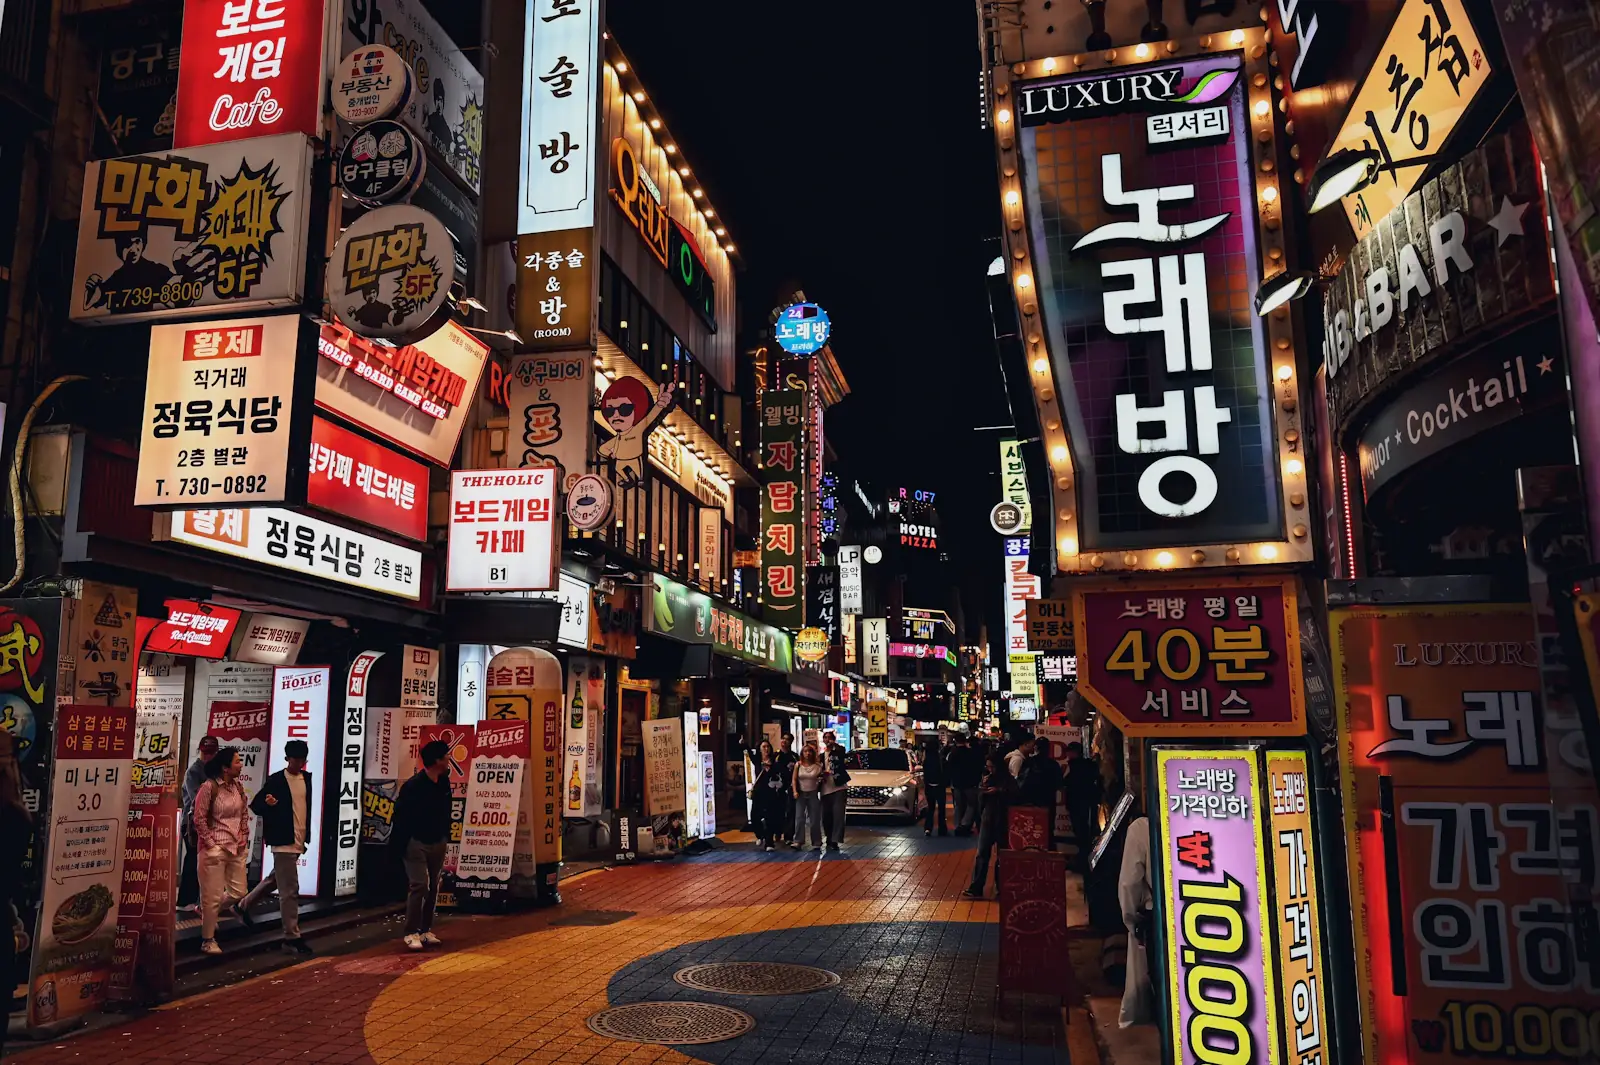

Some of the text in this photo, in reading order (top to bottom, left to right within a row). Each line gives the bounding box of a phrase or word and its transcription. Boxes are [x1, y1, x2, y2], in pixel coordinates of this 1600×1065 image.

[215, 0, 286, 38] 보드
[214, 36, 287, 83] 게임
[339, 75, 393, 96] 부동산
[1022, 69, 1180, 116] LUXURY
[209, 86, 284, 132] Cafe
[1151, 108, 1228, 139] 럭셔리
[343, 158, 409, 183] 당구클럽
[98, 157, 208, 240] 만화
[366, 181, 383, 195] 4F
[345, 225, 426, 293] 만화
[524, 247, 586, 273] 각종술
[215, 257, 260, 294] 5F
[405, 274, 432, 296] 5F
[545, 275, 561, 292] &
[104, 280, 204, 309] T.739-8800
[538, 295, 568, 326] 방
[788, 309, 803, 319] 24
[193, 328, 253, 359] 황제
[533, 327, 572, 339] (ROOM)
[778, 321, 828, 343] 노래방
[1071, 153, 1232, 518] 노래방
[193, 366, 248, 390] 직거래
[355, 361, 394, 391] BOARD
[393, 382, 422, 407] GAME
[421, 399, 447, 420] CAFE
[538, 387, 551, 401] &
[1406, 354, 1529, 446] Cocktail
[152, 395, 283, 439] 정육식당
[764, 404, 800, 426] 웰빙
[177, 446, 249, 468] 2층 별관
[179, 474, 267, 496] 730-0892
[355, 462, 416, 511] 레드버튼
[454, 498, 550, 524] 보드게임
[766, 440, 798, 599] 자담치킨
[192, 509, 243, 542] 황제
[900, 523, 938, 538] HOTEL
[266, 516, 413, 585] 정육식당 2층 별관
[476, 530, 525, 554] 카페
[900, 535, 937, 549] PIZZA
[840, 551, 859, 564] LP
[489, 567, 508, 581] B1
[840, 566, 859, 579] 음악
[1038, 602, 1066, 618] 하나
[1116, 598, 1187, 620] 노래방
[167, 610, 230, 634] 보드게임카페
[709, 606, 744, 651] 자담치킨
[1032, 620, 1074, 637] 부동산
[250, 624, 302, 645] 보드게임카페
[869, 620, 880, 666] YUME
[1106, 625, 1270, 682] 40분
[281, 674, 323, 691] HOLIC
[350, 657, 371, 696] 황제
[403, 678, 437, 697] 정육식당
[1140, 688, 1251, 719] 서비스
[67, 714, 128, 732] 삼겹살과
[211, 711, 268, 730] HOLIC
[545, 705, 556, 748] 쓰레기
[1365, 691, 1540, 767] 노래
[65, 734, 126, 751] 어울리는
[149, 733, 170, 754] 5F
[476, 728, 525, 748] HOLIC
[478, 729, 492, 737] THE
[65, 767, 120, 787] 미나리
[340, 707, 364, 849] 정육식당
[476, 770, 515, 784] OPEN
[1176, 768, 1238, 794] 노래방
[77, 793, 102, 812] 3.0
[363, 786, 396, 826] 만화
[1169, 794, 1249, 819] 가격인하
[1271, 773, 1306, 816] 노래방
[460, 854, 511, 866] 보드게임카페
[1178, 870, 1253, 1065] 10.00
